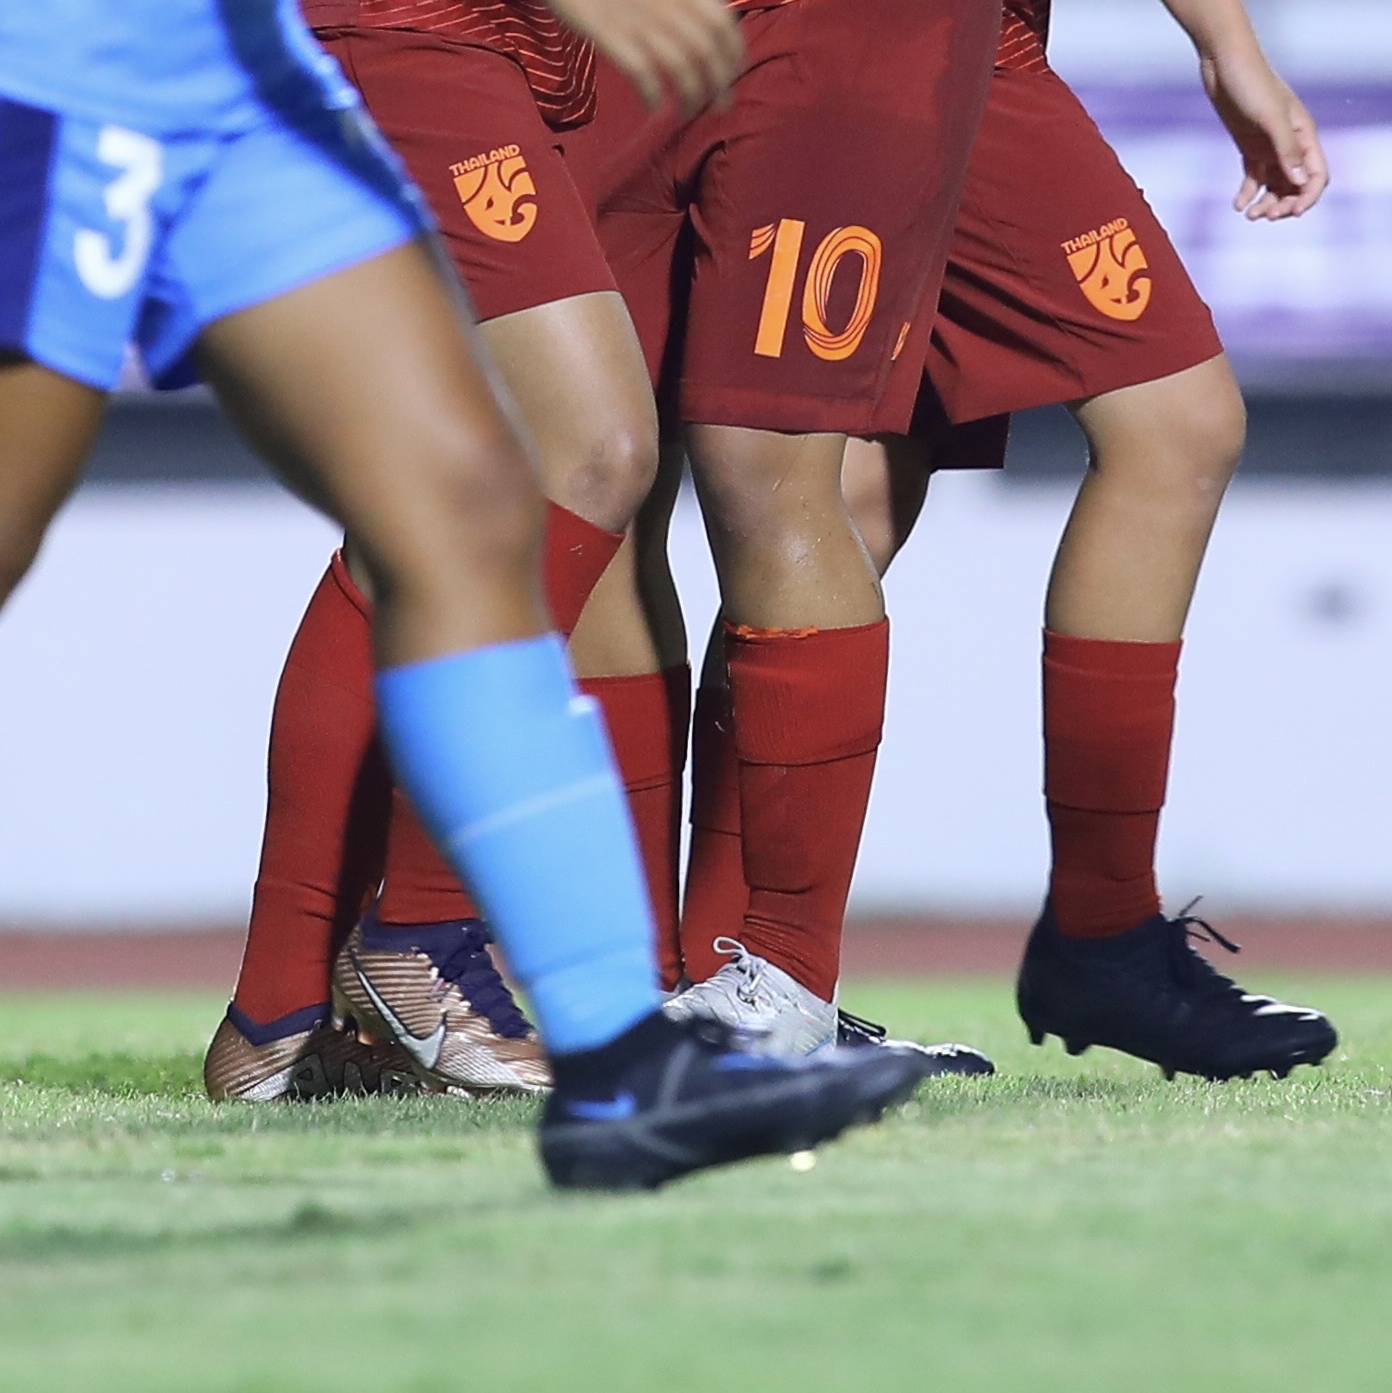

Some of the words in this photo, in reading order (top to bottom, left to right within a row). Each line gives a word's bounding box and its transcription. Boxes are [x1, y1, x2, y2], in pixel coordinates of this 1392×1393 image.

[448, 144, 521, 176] THAILAND
[73, 123, 164, 300] 3
[1060, 217, 1128, 255] THAILAND
[748, 218, 882, 361] 10
